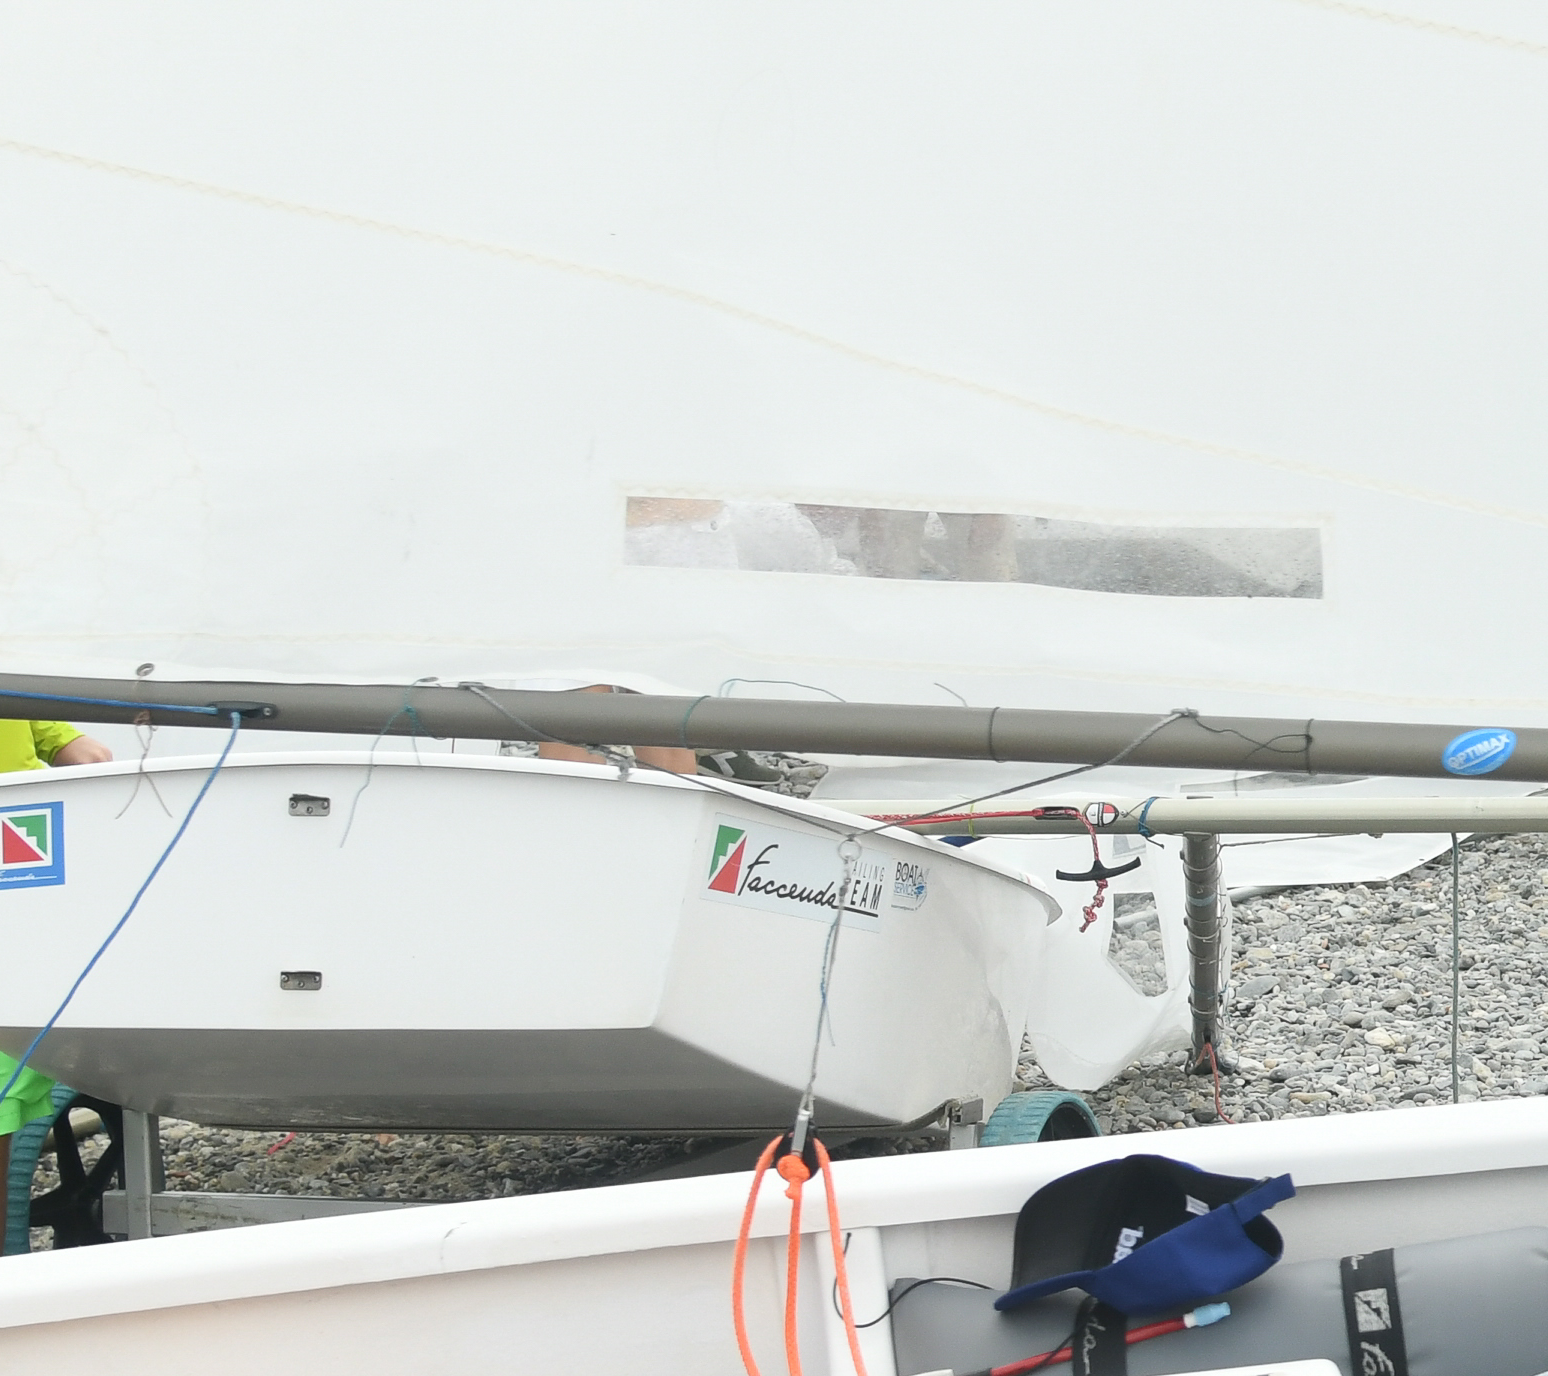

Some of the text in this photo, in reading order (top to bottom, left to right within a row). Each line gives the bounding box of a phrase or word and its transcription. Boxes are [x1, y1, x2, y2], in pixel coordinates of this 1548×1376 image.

[1448, 733, 1511, 770] OPTIMAX
[851, 861, 885, 882] AILING
[850, 879, 883, 911] EAM
